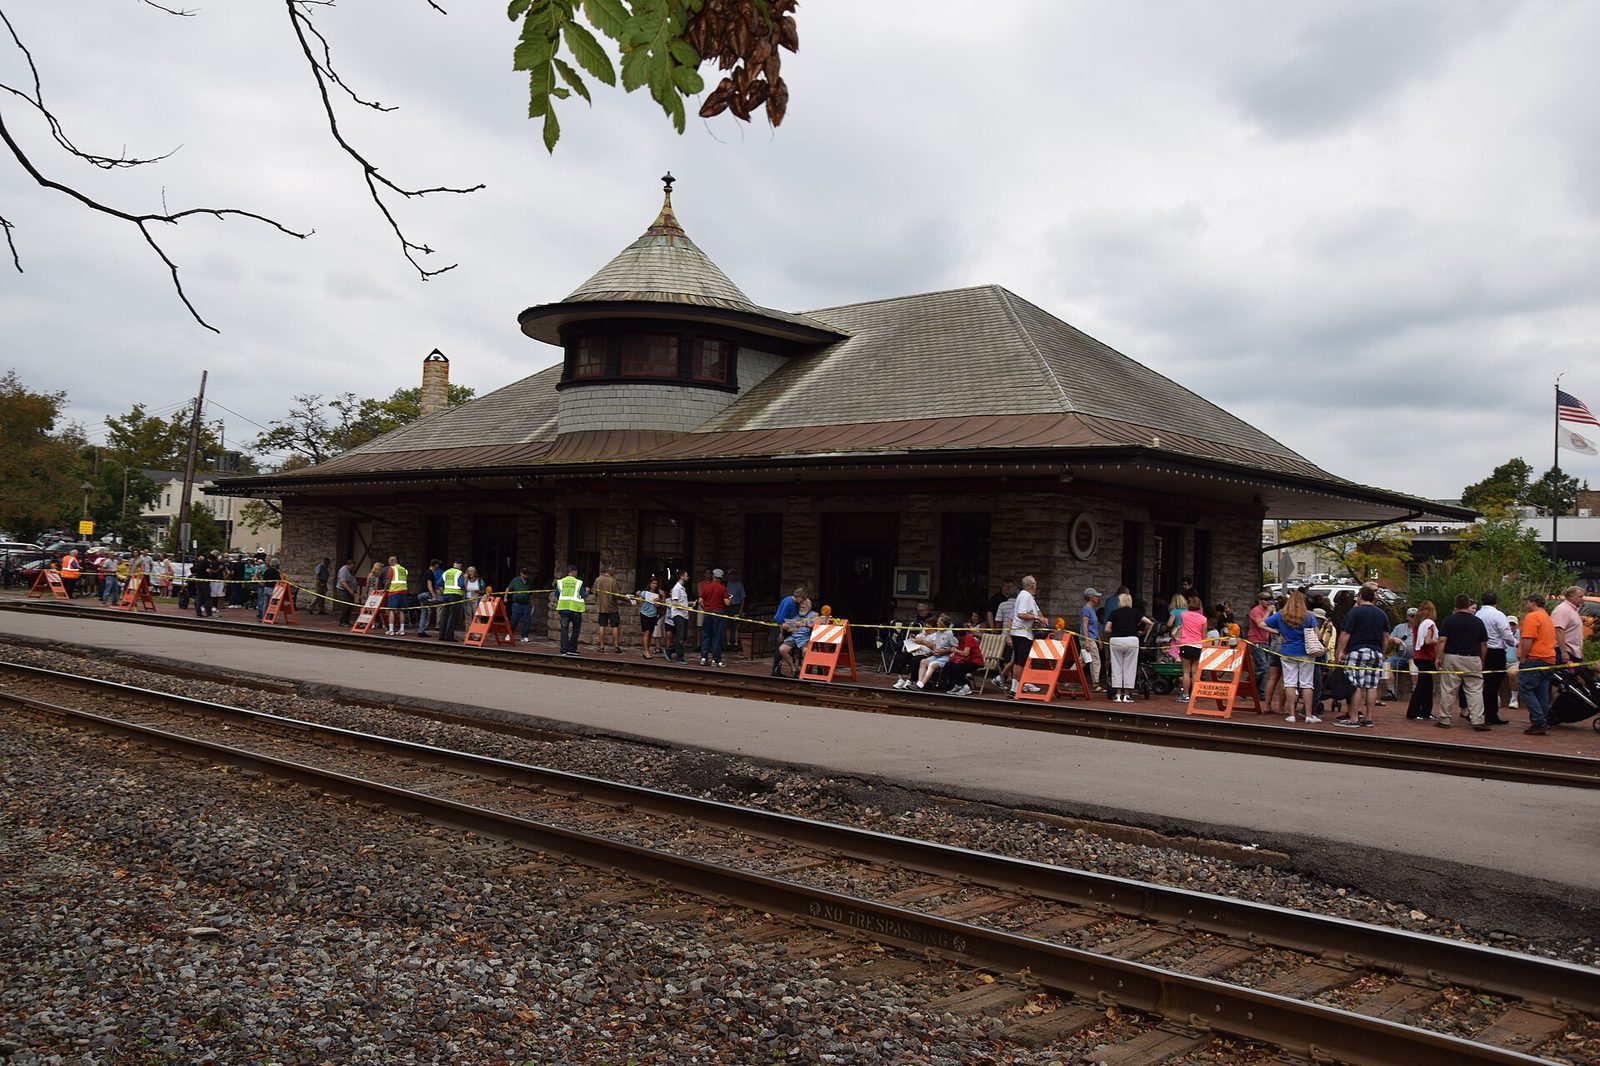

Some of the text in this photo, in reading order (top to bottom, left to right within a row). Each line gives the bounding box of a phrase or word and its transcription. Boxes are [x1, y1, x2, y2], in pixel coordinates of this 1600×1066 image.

[1420, 526, 1439, 535] UPS
[825, 906, 949, 947] NO TRESPASSING
